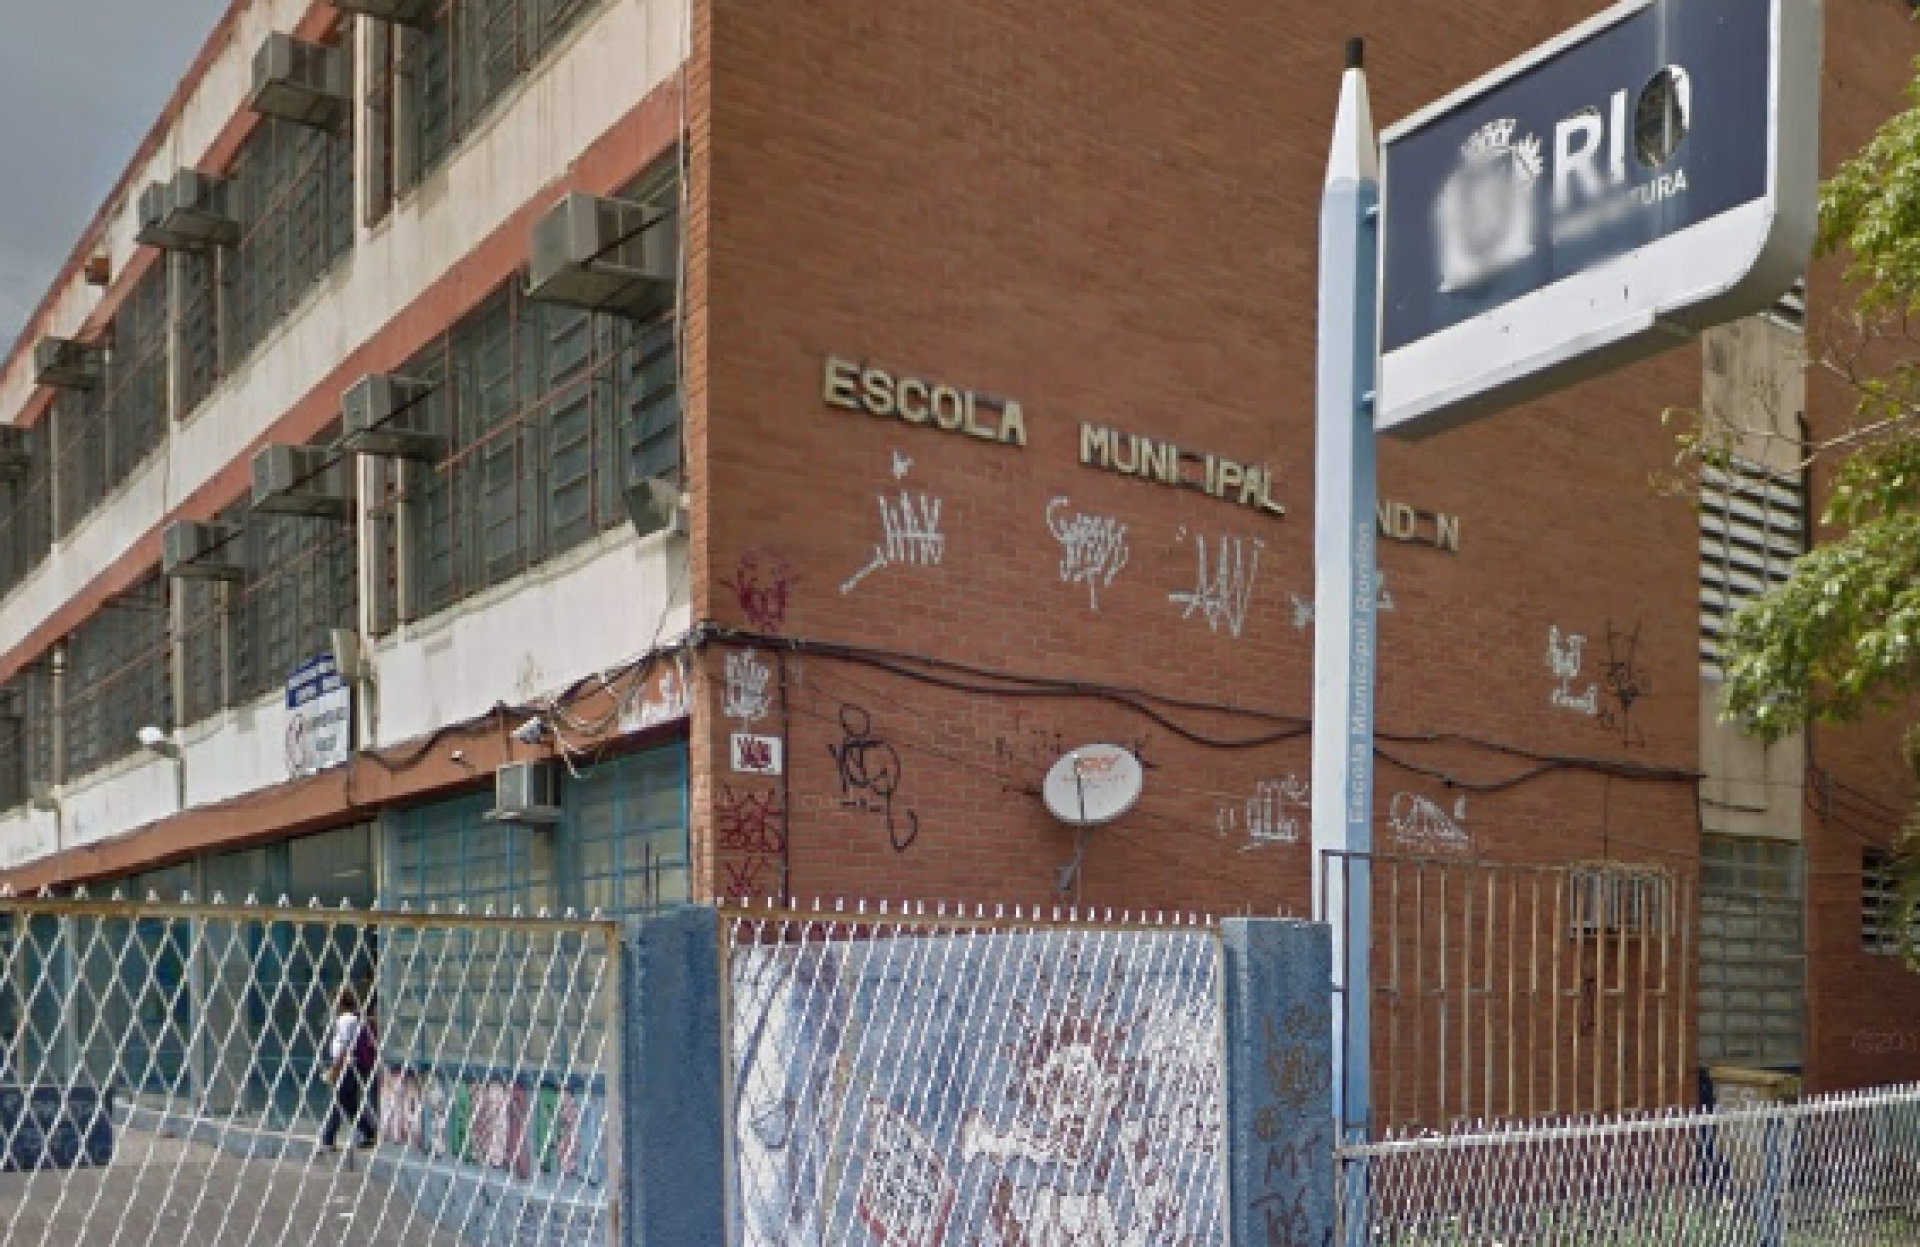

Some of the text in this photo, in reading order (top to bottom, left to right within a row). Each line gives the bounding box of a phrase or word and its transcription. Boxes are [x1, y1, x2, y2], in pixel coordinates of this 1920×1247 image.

[824, 355, 1027, 446] ESCOLA
[1079, 421, 1286, 515] MUNIIPAL
[1352, 618, 1371, 735] Municipal
[1349, 742, 1366, 824] Escola
